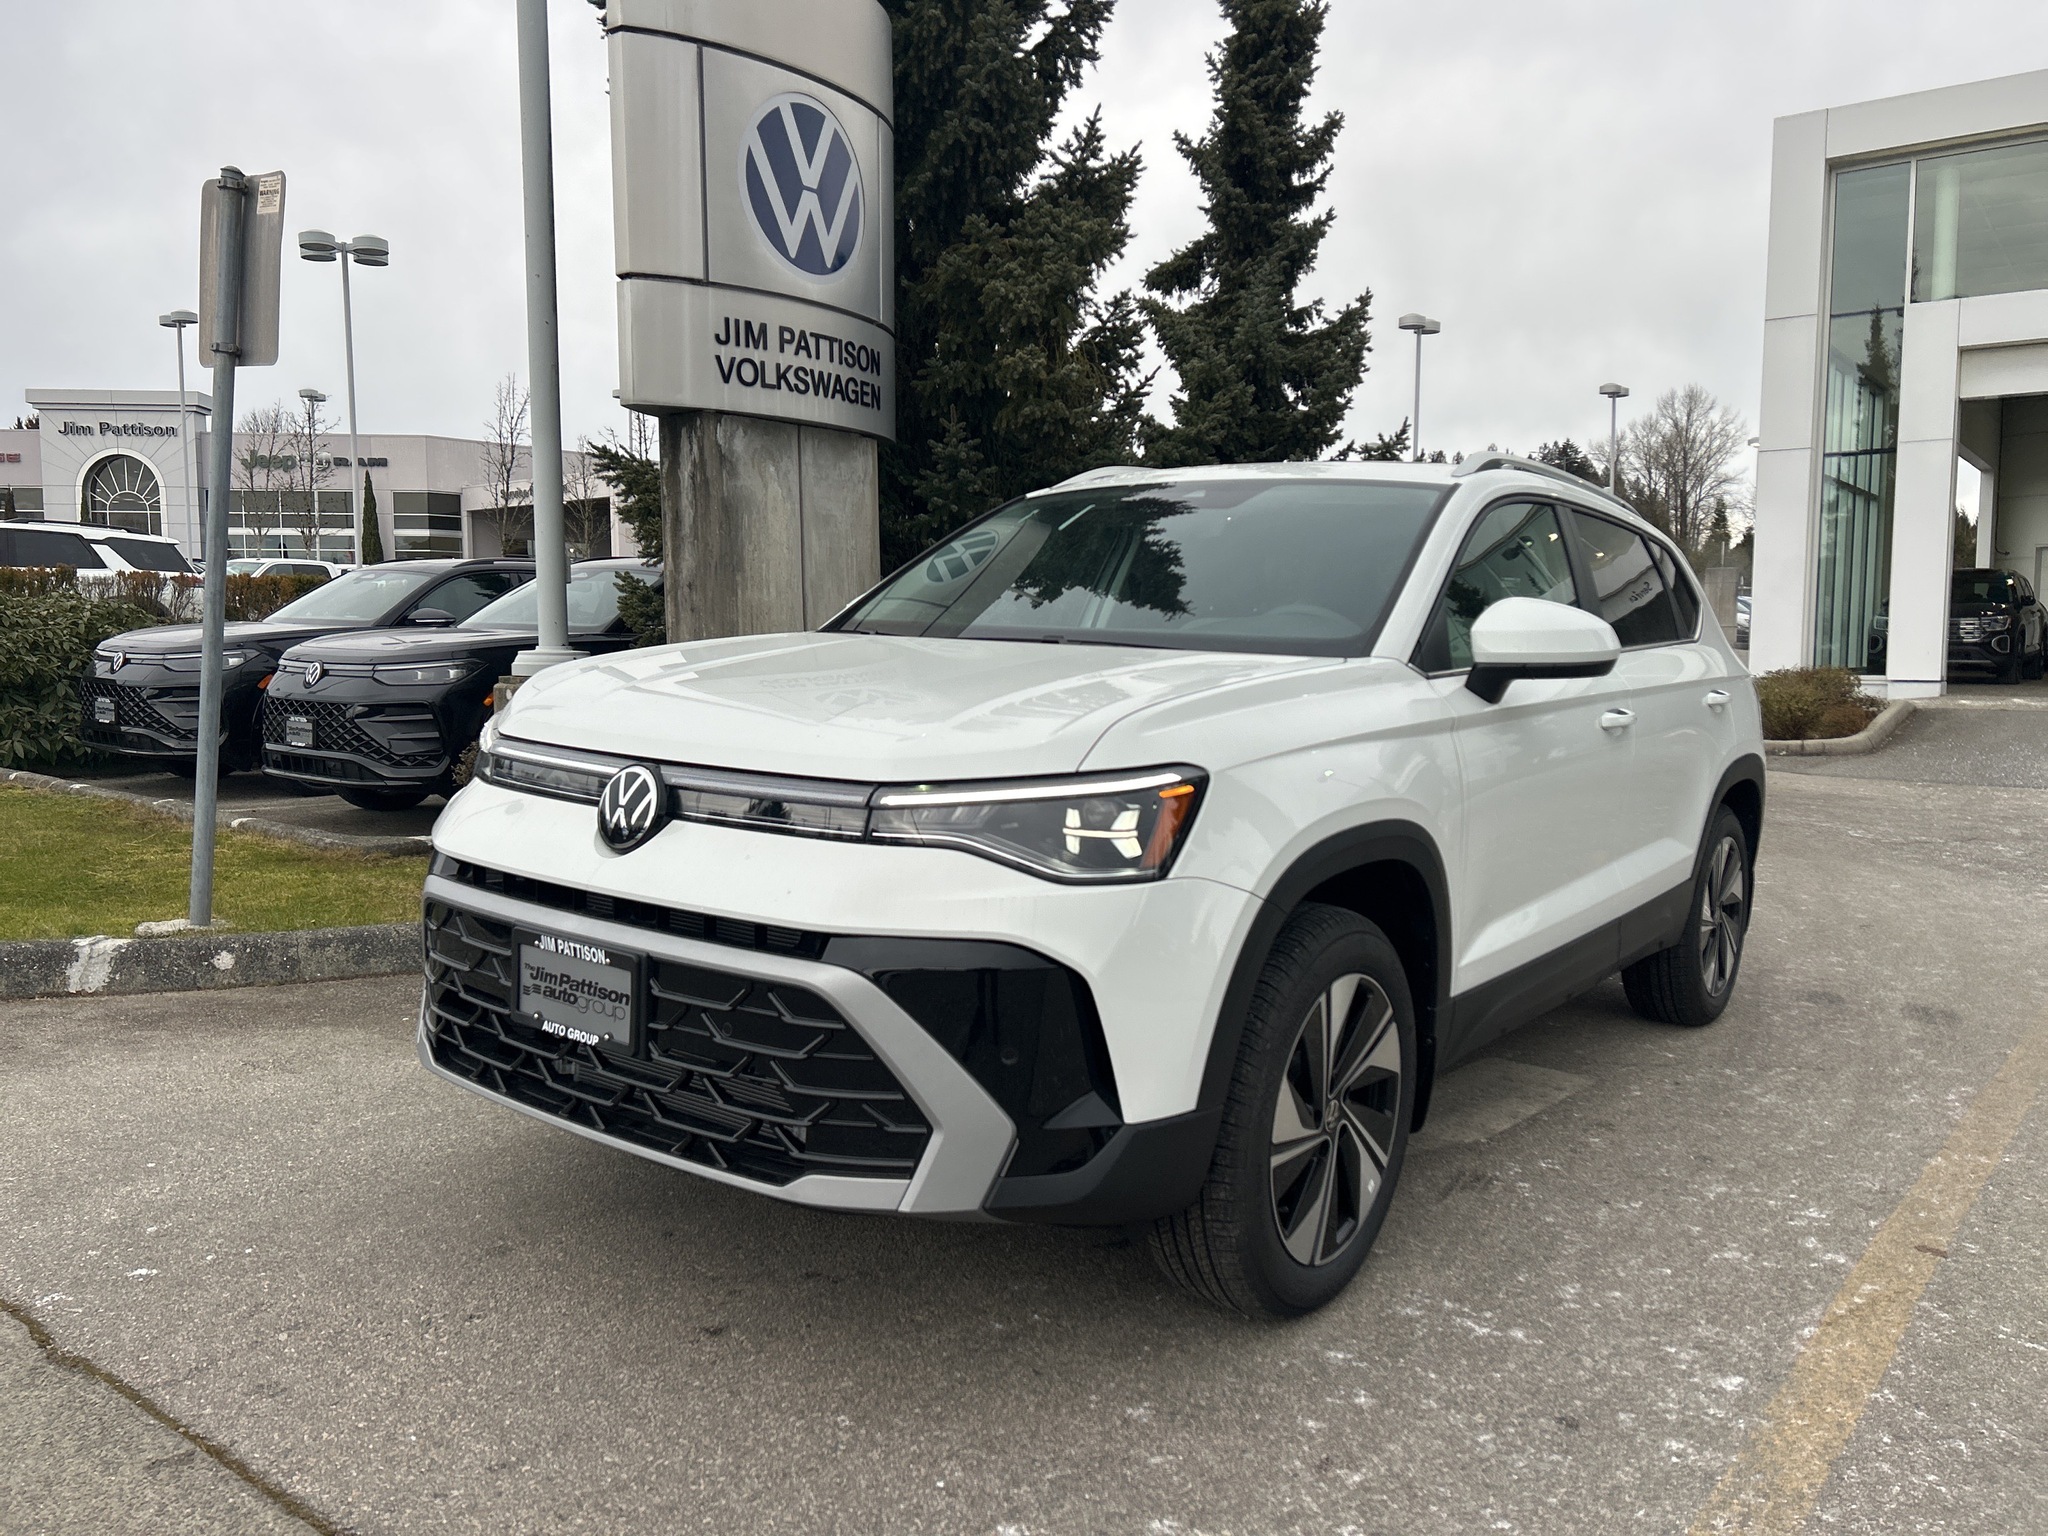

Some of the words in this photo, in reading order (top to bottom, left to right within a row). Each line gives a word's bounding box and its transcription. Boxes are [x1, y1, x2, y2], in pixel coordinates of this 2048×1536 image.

[714, 316, 768, 351] JIM
[778, 325, 881, 377] PATTISON
[714, 354, 881, 411] VOLKSWAGEN
[58, 421, 94, 437] Jim
[99, 421, 178, 437] Pattison
[240, 449, 297, 473] Jeep
[540, 934, 556, 952] JIM
[557, 939, 606, 965] PATTISON
[541, 1020, 566, 1036] AUTO
[567, 1027, 599, 1046] GROUP
